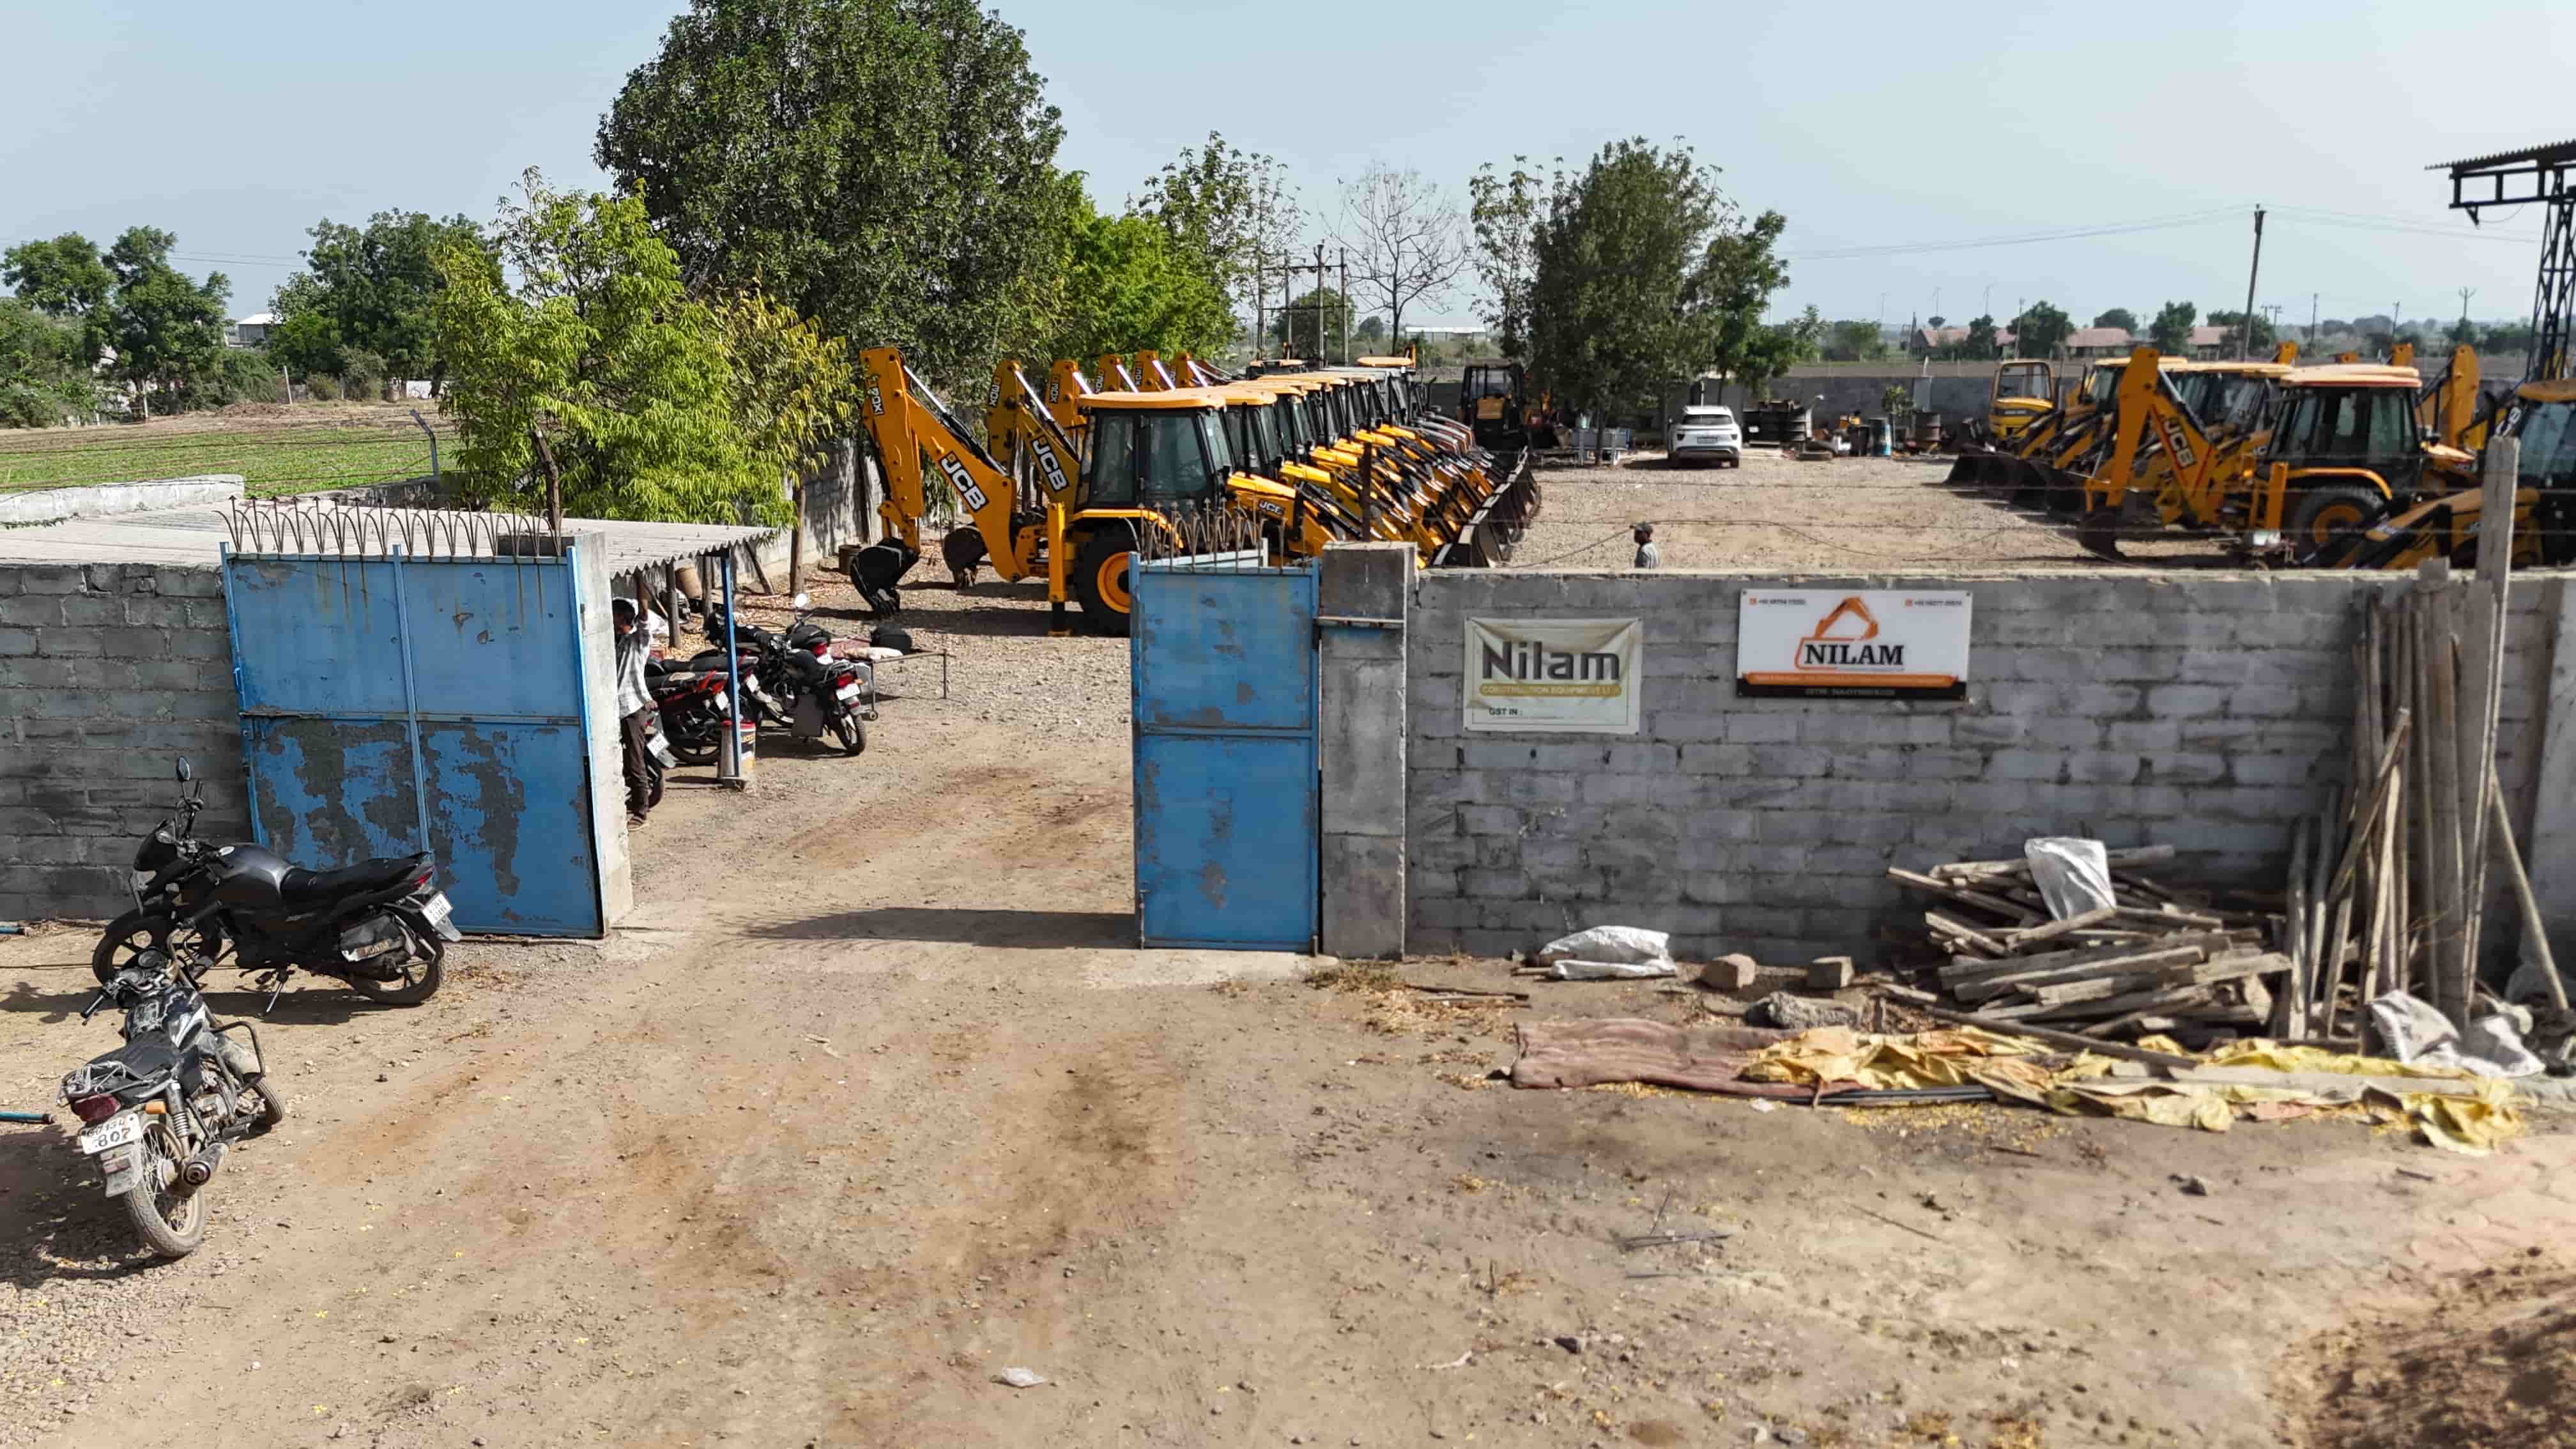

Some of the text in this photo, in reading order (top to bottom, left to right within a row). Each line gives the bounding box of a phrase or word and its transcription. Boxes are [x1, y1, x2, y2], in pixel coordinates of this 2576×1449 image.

[2163, 419, 2195, 467] JCB
[940, 455, 986, 510] JCB
[1032, 440, 1067, 490] JCB
[1482, 640, 1620, 680] Nilam
[1804, 644, 1905, 665] NILAM
[1489, 707, 1506, 716] GST
[93, 1127, 131, 1147] 807
